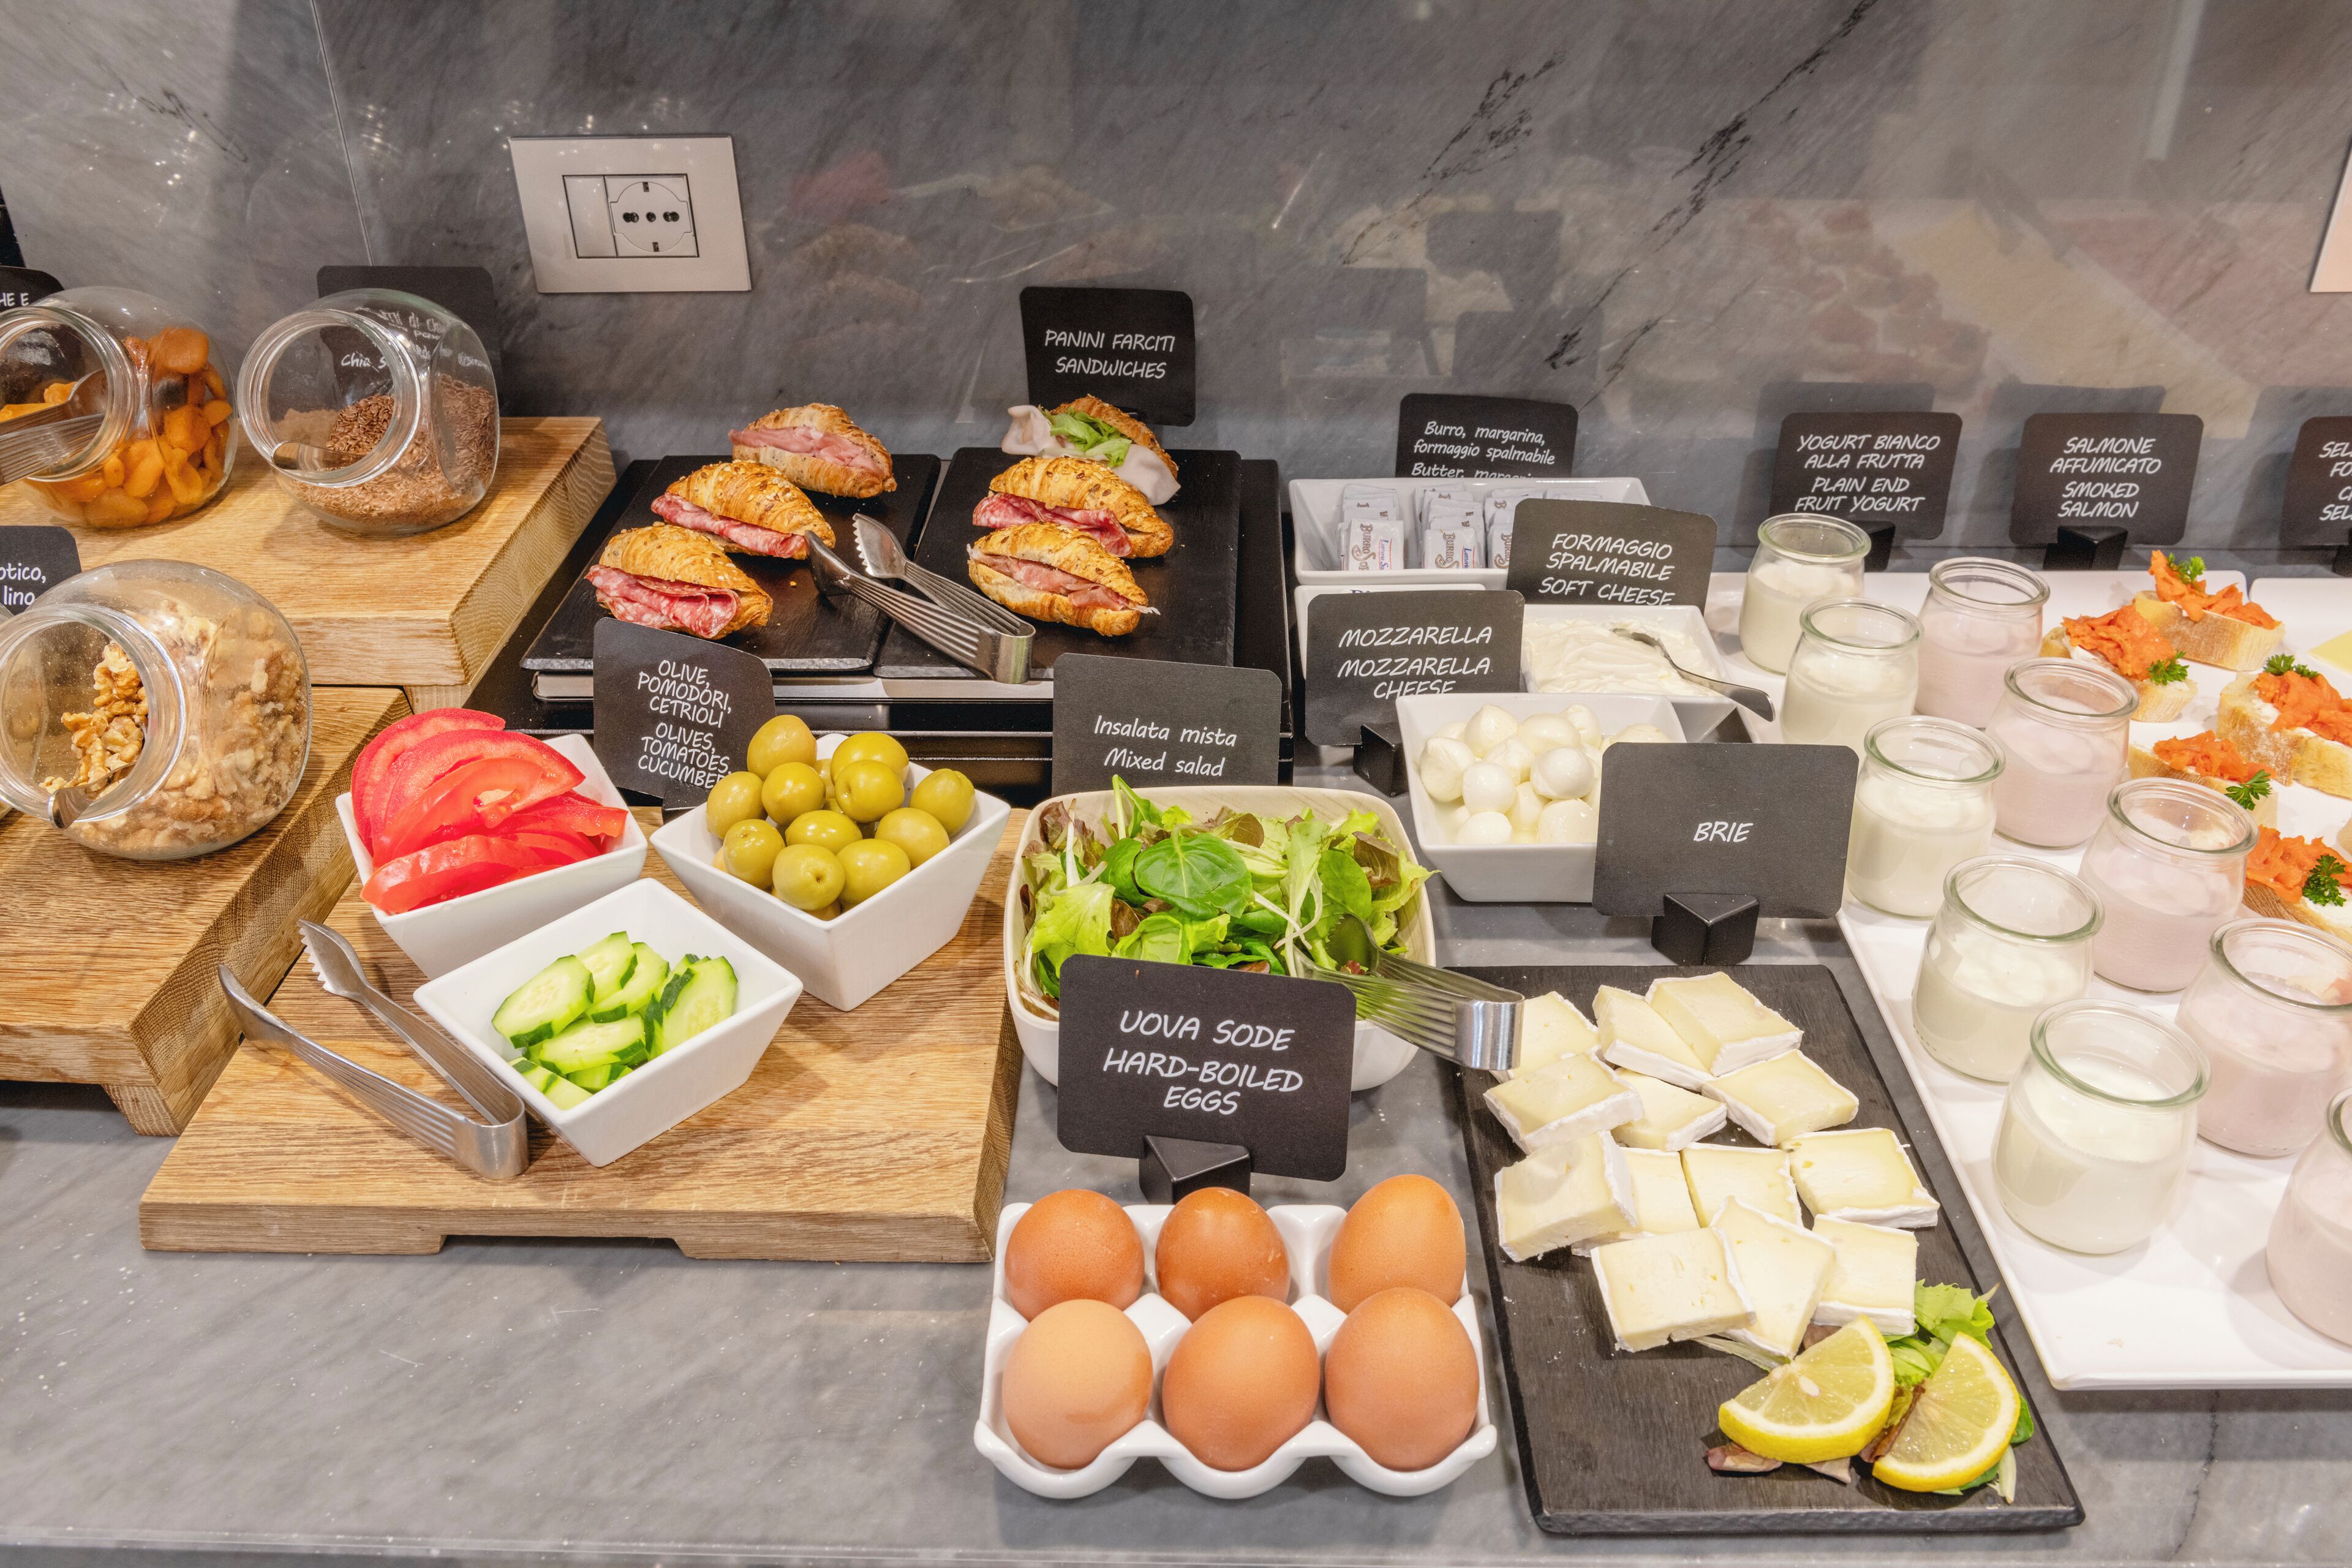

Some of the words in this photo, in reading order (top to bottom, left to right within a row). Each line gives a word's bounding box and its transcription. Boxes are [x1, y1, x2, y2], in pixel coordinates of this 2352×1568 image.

[20, 292, 29, 306] E
[1044, 329, 1105, 349] PANINI
[1112, 334, 1175, 352] FARCITI
[341, 352, 371, 368] Chia
[1055, 356, 1167, 379] SANDWICHES
[1424, 421, 1466, 439] Burro,
[1475, 426, 1545, 446] margarina,
[1796, 434, 1872, 452] YOGURT
[1873, 434, 1941, 450] BIANCO
[1413, 439, 1480, 459] formaggio
[1486, 445, 1556, 464] spalmabile
[2063, 437, 2156, 454] SALMONE
[2318, 441, 2352, 458] SEL
[1804, 454, 1850, 469] ALLA
[1856, 453, 1925, 469] FRUTTA
[2049, 457, 2162, 474] AFFUMICATO
[2329, 461, 2352, 477] FO
[1811, 476, 1867, 493] PLAIN
[1871, 477, 1910, 493] END
[2062, 481, 2140, 499] SMOKED
[1794, 496, 1847, 512] FRUIT
[1850, 495, 1926, 513] YOGURT
[2057, 500, 2139, 518] SALMON
[2319, 503, 2352, 521] SEL
[1442, 532, 1456, 564] BURRO
[1551, 533, 1673, 560] FORMAGGIO
[1546, 552, 1675, 581] SPALMABILE
[4, 585, 36, 606] lino
[1539, 577, 1594, 595] SOFT
[1597, 584, 1676, 606] CHEESE
[1338, 626, 1493, 648] MOZZARELLA
[658, 659, 709, 689] OLIVE,
[1336, 657, 1491, 677] MOZZARELLA
[638, 671, 732, 714] POMODORI,
[1373, 679, 1457, 699] CHEESE
[649, 696, 724, 728] CETRIOLI
[655, 722, 716, 755] OLIVES,
[1094, 715, 1170, 741] Insalata
[1180, 726, 1237, 747] mista
[1104, 747, 1167, 771] Mixed
[1175, 755, 1226, 777] salad
[1693, 821, 1754, 843] BRIE
[1120, 1010, 1200, 1040] UOVA
[1213, 1019, 1295, 1051] SODE
[1102, 1047, 1303, 1092] HARD-BOILED
[1163, 1085, 1241, 1115] EGGS
